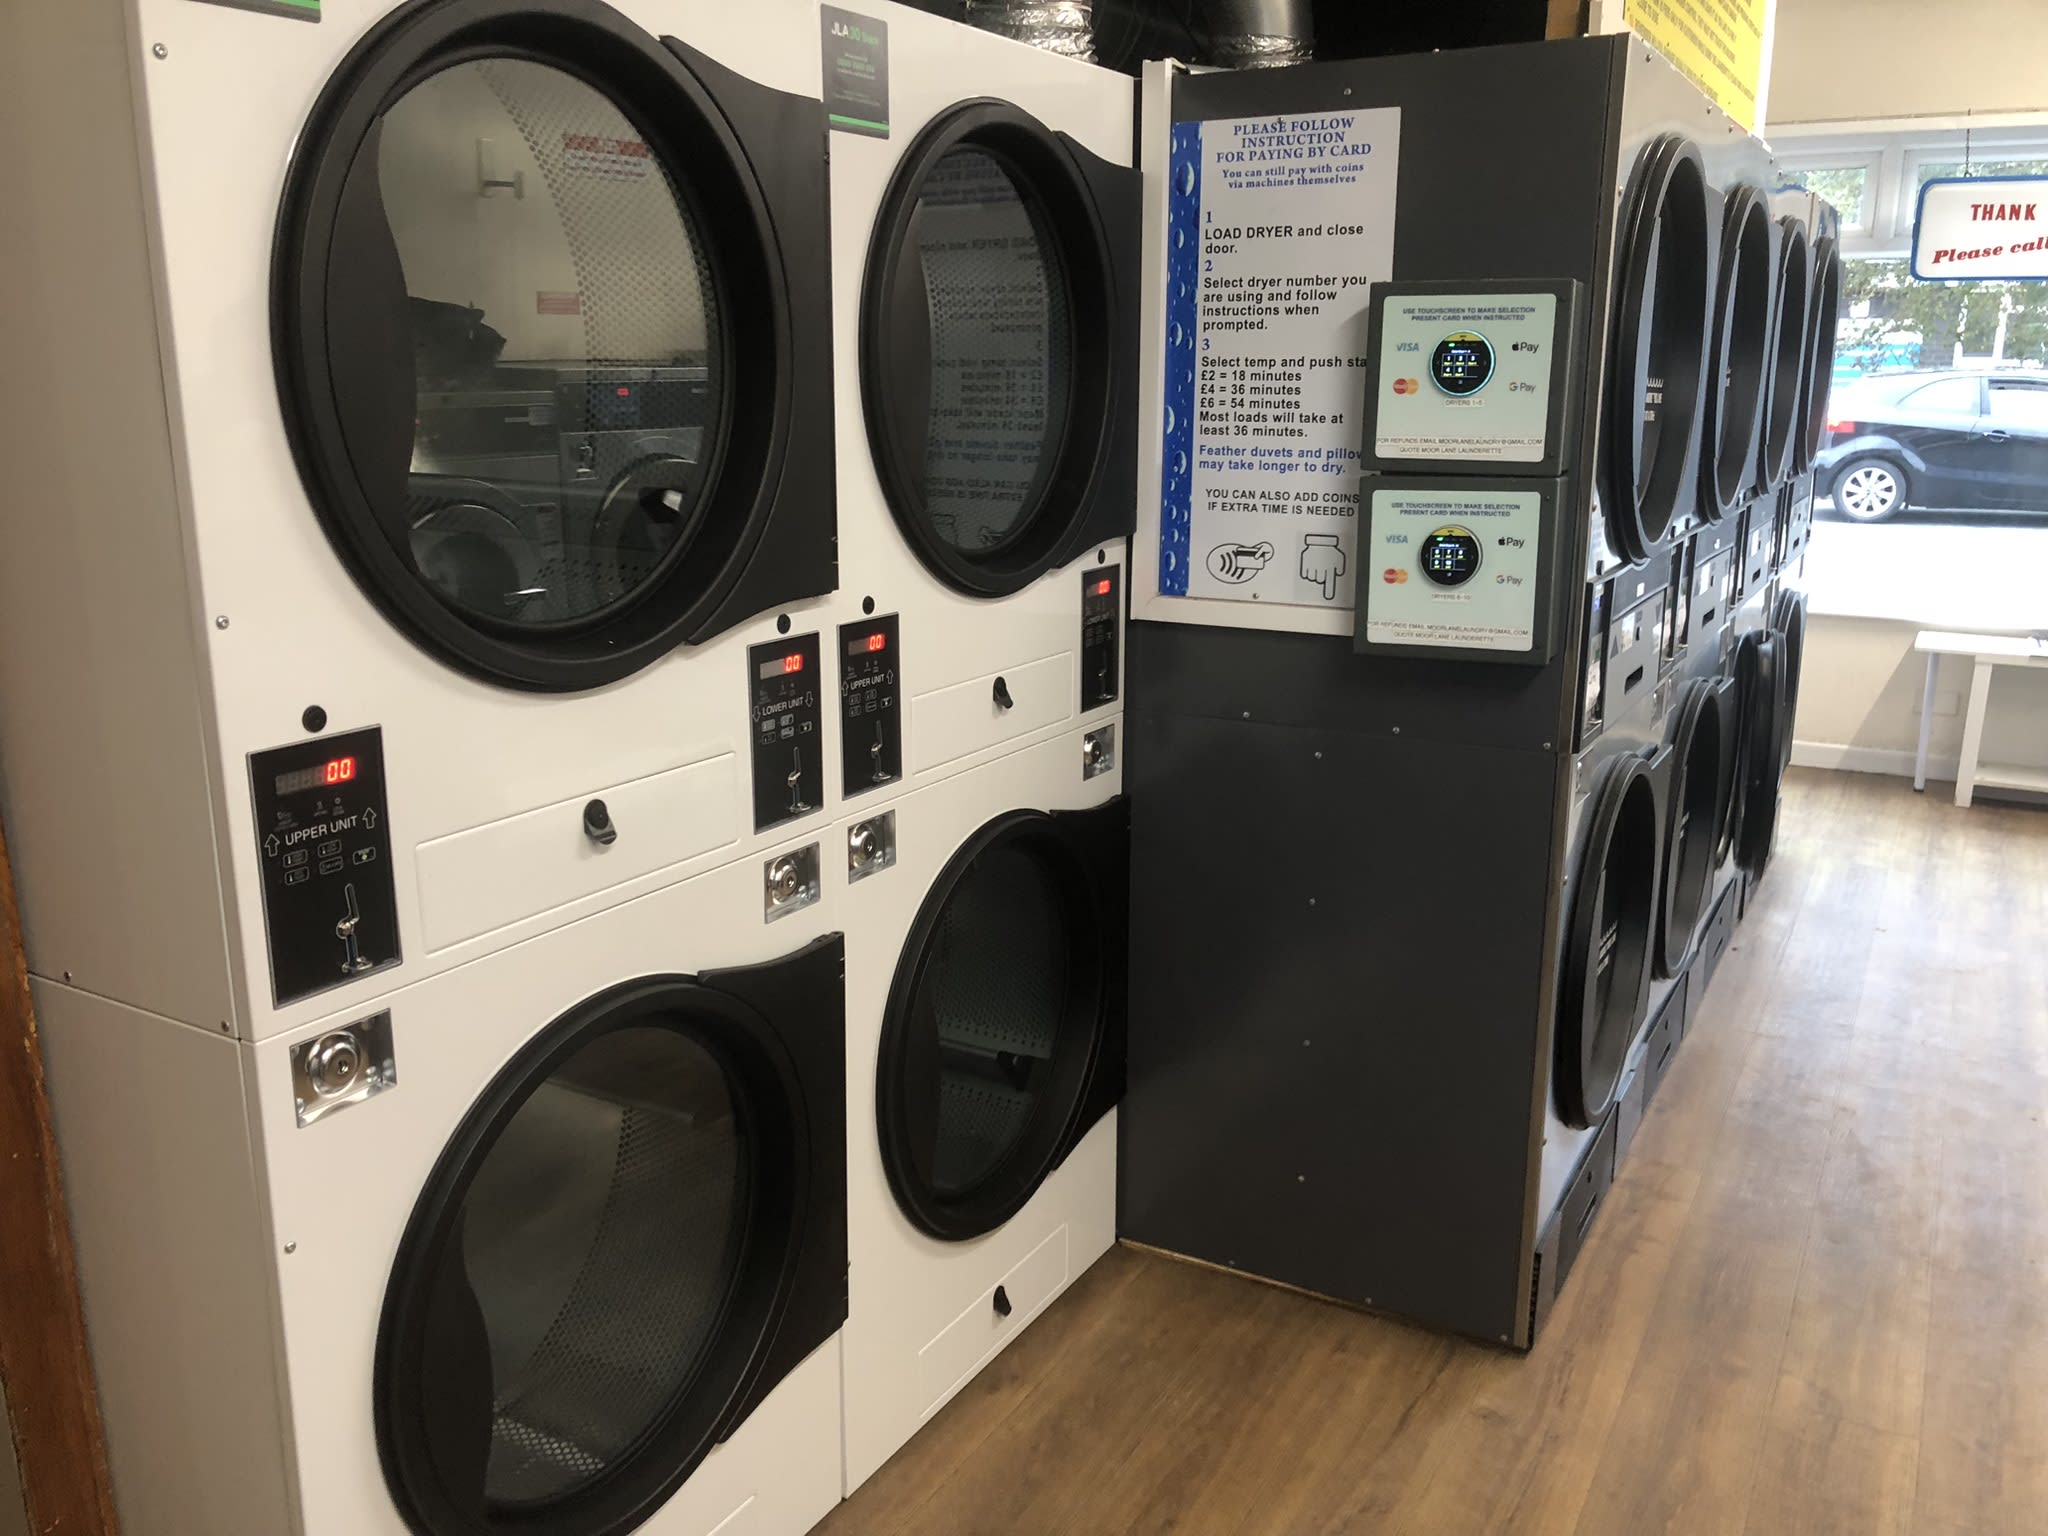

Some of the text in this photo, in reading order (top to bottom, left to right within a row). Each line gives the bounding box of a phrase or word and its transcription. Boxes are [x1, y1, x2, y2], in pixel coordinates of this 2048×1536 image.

[831, 22, 849, 37] JLA
[1233, 117, 1355, 136] PLEASE FOLLOW
[1241, 131, 1346, 149] INSTRUCTION
[1216, 143, 1372, 164] FOR PAYING BY CARD
[1222, 163, 1364, 179] You can still pay with coins
[1228, 174, 1356, 189] via machines themselves
[1206, 211, 1212, 224] 1
[1971, 204, 2037, 221] THANK
[1205, 223, 1364, 240] LOAD DRYER and close
[1205, 242, 1238, 254] door.
[1931, 245, 2004, 264] Please
[1204, 260, 1214, 273] 2
[1204, 274, 1367, 291] Select dryer number you
[1203, 288, 1337, 305] are using and follow
[1202, 304, 1319, 317] instructions when
[1417, 307, 1466, 315] TOUCHSCREEN
[1498, 306, 1536, 314] SELECTION
[1203, 319, 1268, 333] prompted.
[1202, 339, 1210, 351] 3
[1396, 342, 1420, 352] VISA
[1520, 342, 1539, 354] Pay
[1202, 356, 1240, 368] Select
[1244, 356, 1276, 370] temp
[1281, 356, 1305, 368] and
[1310, 356, 1342, 370] push
[1201, 370, 1216, 382] £2
[1231, 370, 1246, 381] 18
[1250, 370, 1302, 382] minutes
[1200, 384, 1215, 395] £4
[1231, 384, 1246, 395] 36
[1250, 384, 1301, 396] minutes
[1520, 382, 1536, 393] Pay
[1200, 398, 1215, 409] £6
[1230, 398, 1245, 409] 54
[1249, 398, 1301, 410] minutes
[1199, 411, 1344, 424] Most loads will take at
[1200, 425, 1308, 437] least 36 minutes.
[1199, 445, 1247, 457] Feather
[1252, 446, 1293, 458] duvets
[1298, 447, 1322, 459] and
[1199, 459, 1346, 476] may take longer to dry.
[1205, 489, 1360, 504] YOU CAN ALSO ADD COINS
[1208, 502, 1354, 518] IF EXTRA TIME IS NEEDED
[1386, 535, 1408, 544] VISA
[1507, 537, 1525, 549] Pay
[1507, 576, 1523, 587] Pay
[869, 635, 882, 650] 00
[785, 655, 800, 672] 00
[850, 673, 885, 690] UPPER UNIT
[762, 695, 804, 716] LOWER UNIT
[327, 758, 352, 782] 00
[285, 815, 358, 846] UPPER UNIT
